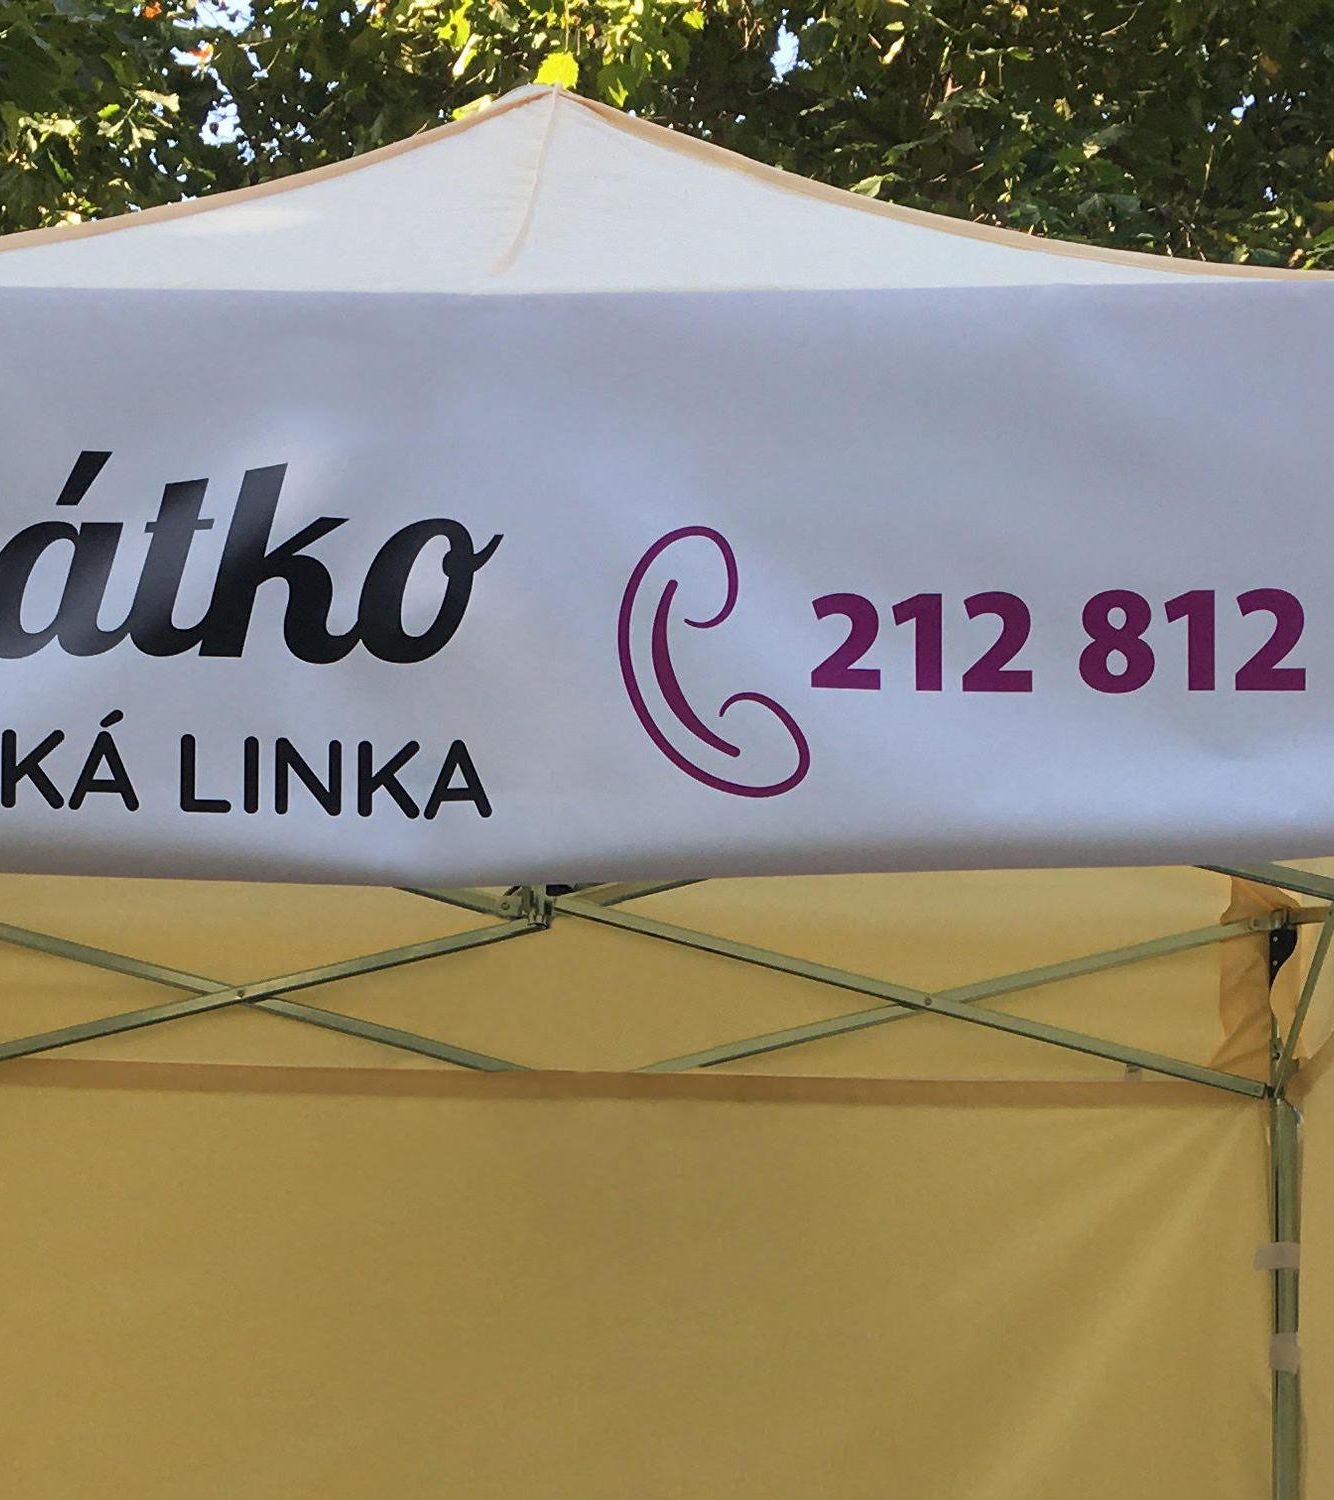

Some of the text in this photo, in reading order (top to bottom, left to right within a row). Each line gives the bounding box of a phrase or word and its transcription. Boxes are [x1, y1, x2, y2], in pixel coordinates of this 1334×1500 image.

[810, 590, 1033, 693] 212
[1077, 588, 1305, 694] 812
[179, 735, 493, 819] LINKA
